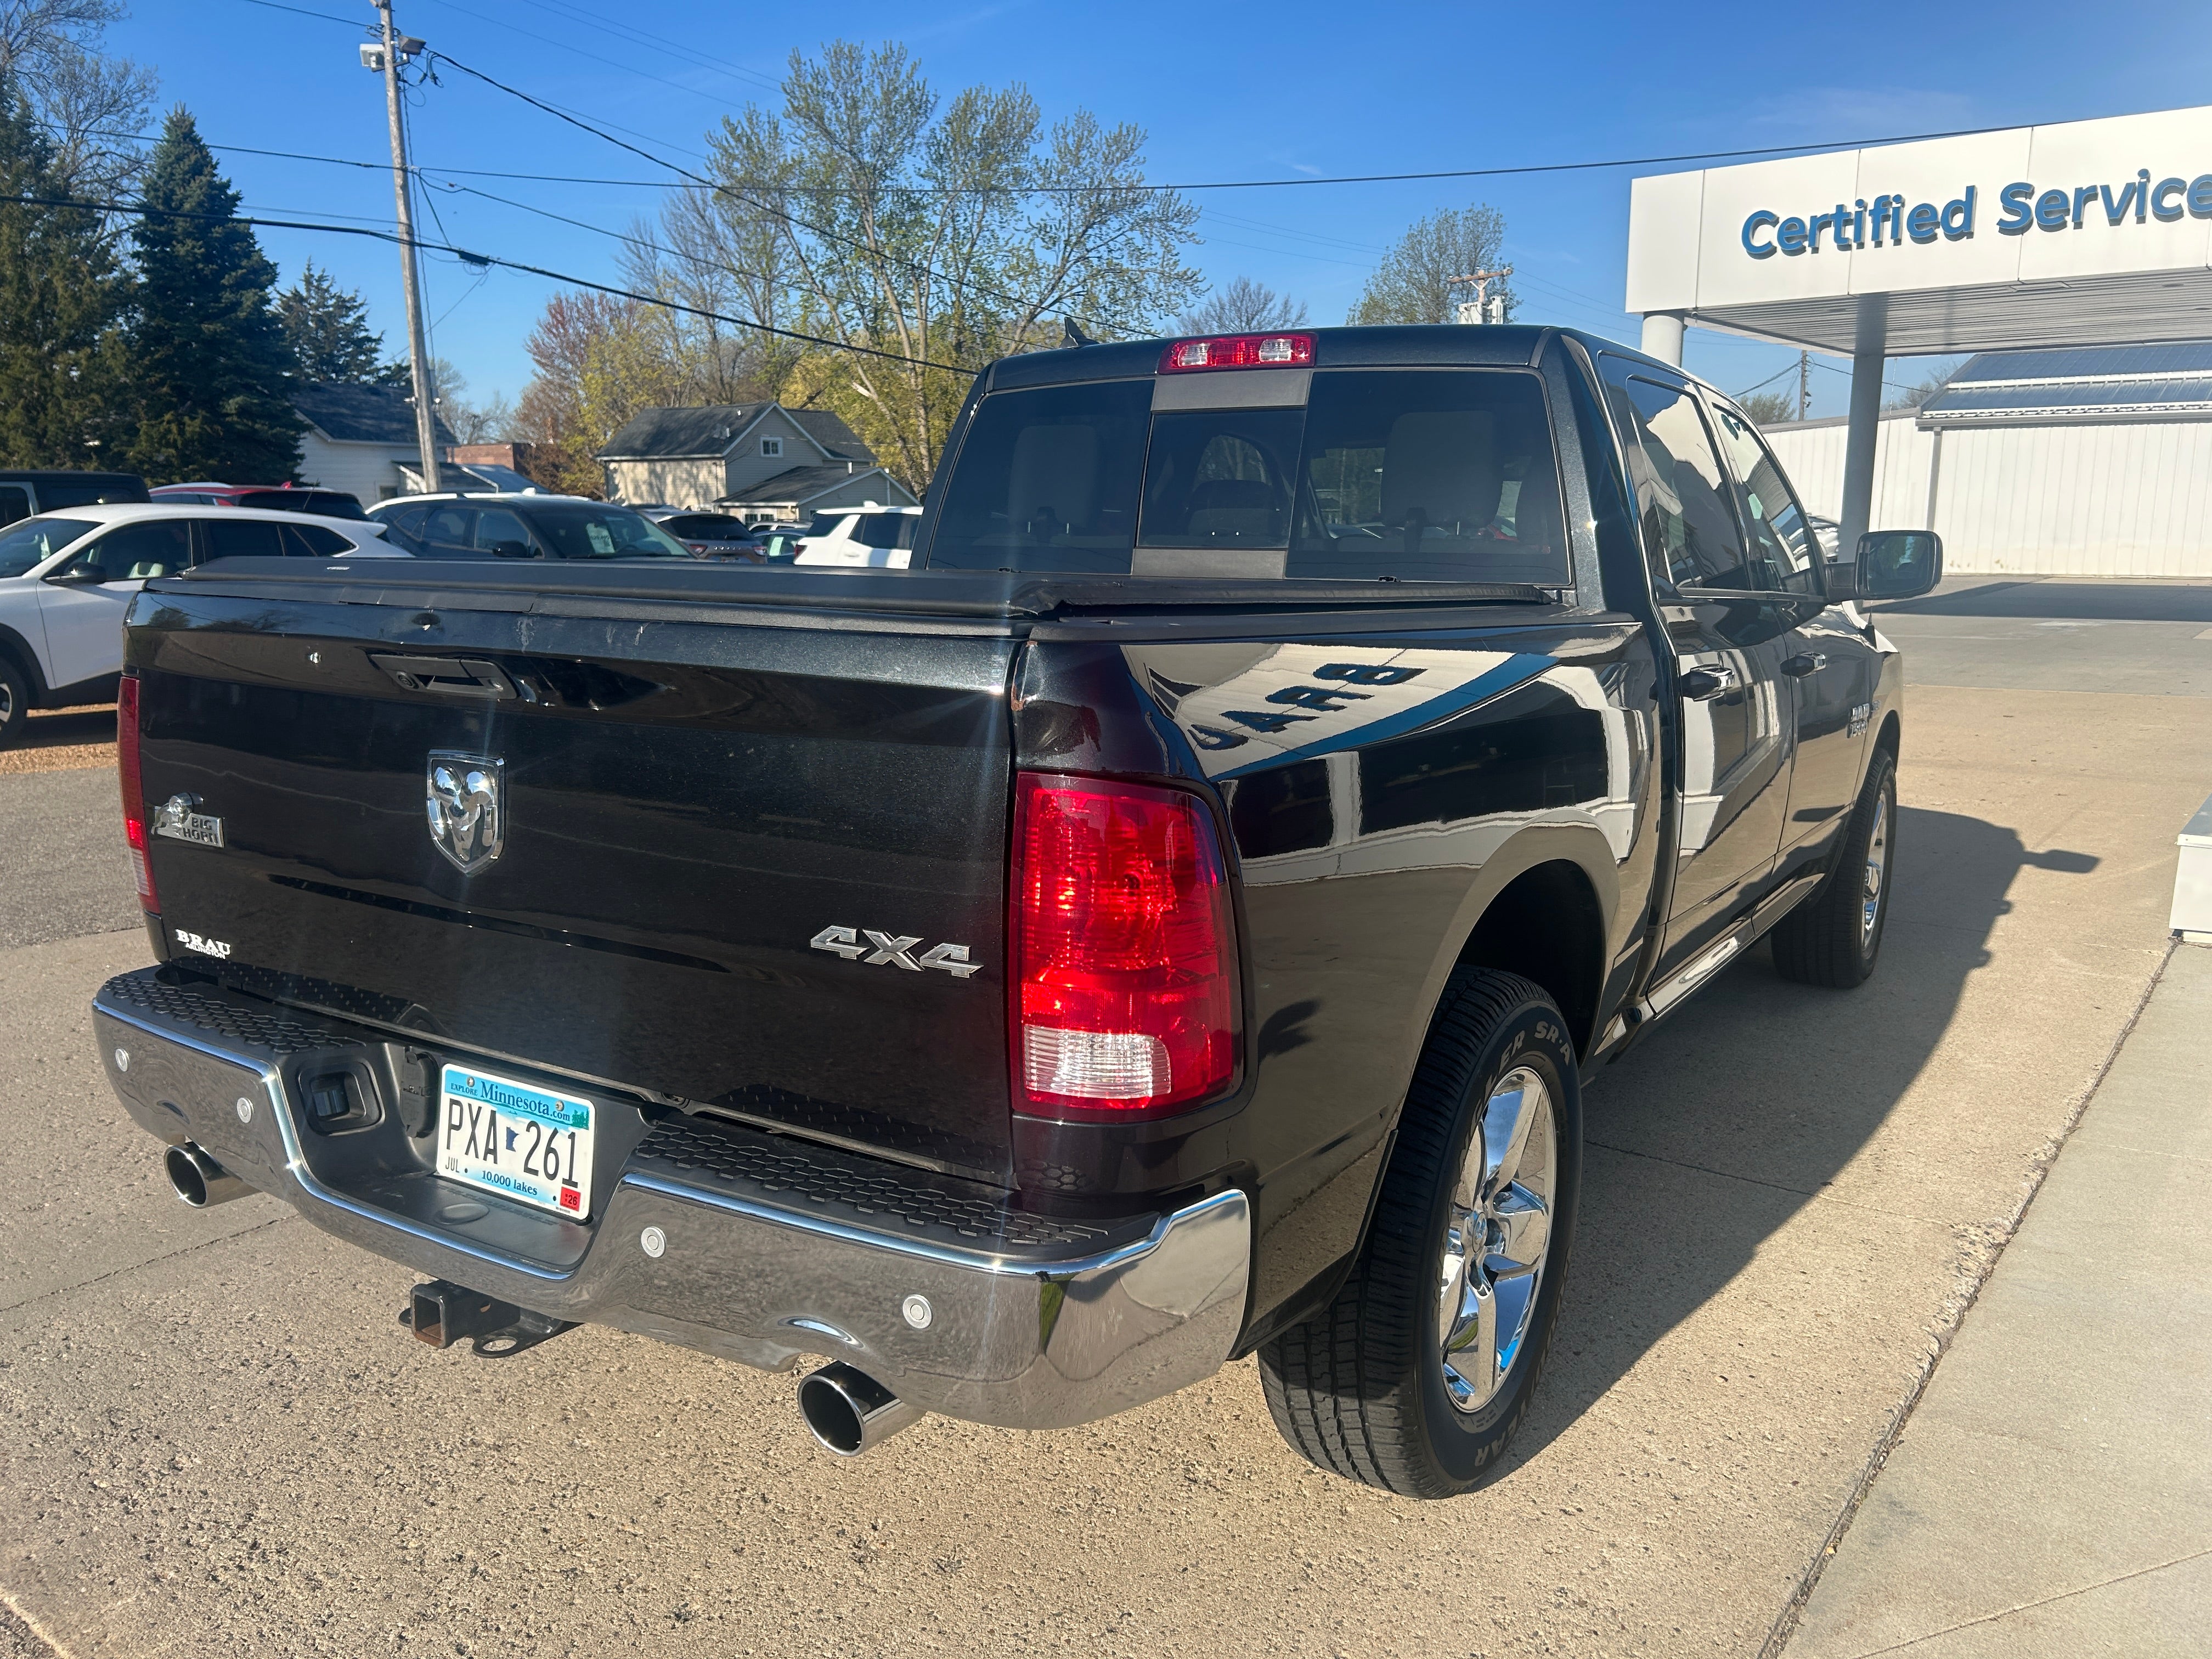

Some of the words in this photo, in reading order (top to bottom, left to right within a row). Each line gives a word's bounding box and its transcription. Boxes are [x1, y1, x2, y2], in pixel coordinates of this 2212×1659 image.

[1742, 185, 1978, 259] Certified
[1997, 168, 2212, 237] Service
[191, 816, 212, 830] BIG
[183, 827, 218, 845] HORN
[176, 929, 230, 955] BRAU
[185, 942, 226, 960] ARLINGTON
[451, 1082, 478, 1096] EXPLORE
[446, 1098, 498, 1164] PXA
[523, 1120, 579, 1188] 261
[445, 1156, 460, 1173] JUL
[482, 1170, 511, 1188] 10,000
[514, 1179, 538, 1195] lakes
[567, 1194, 578, 1206] 26
